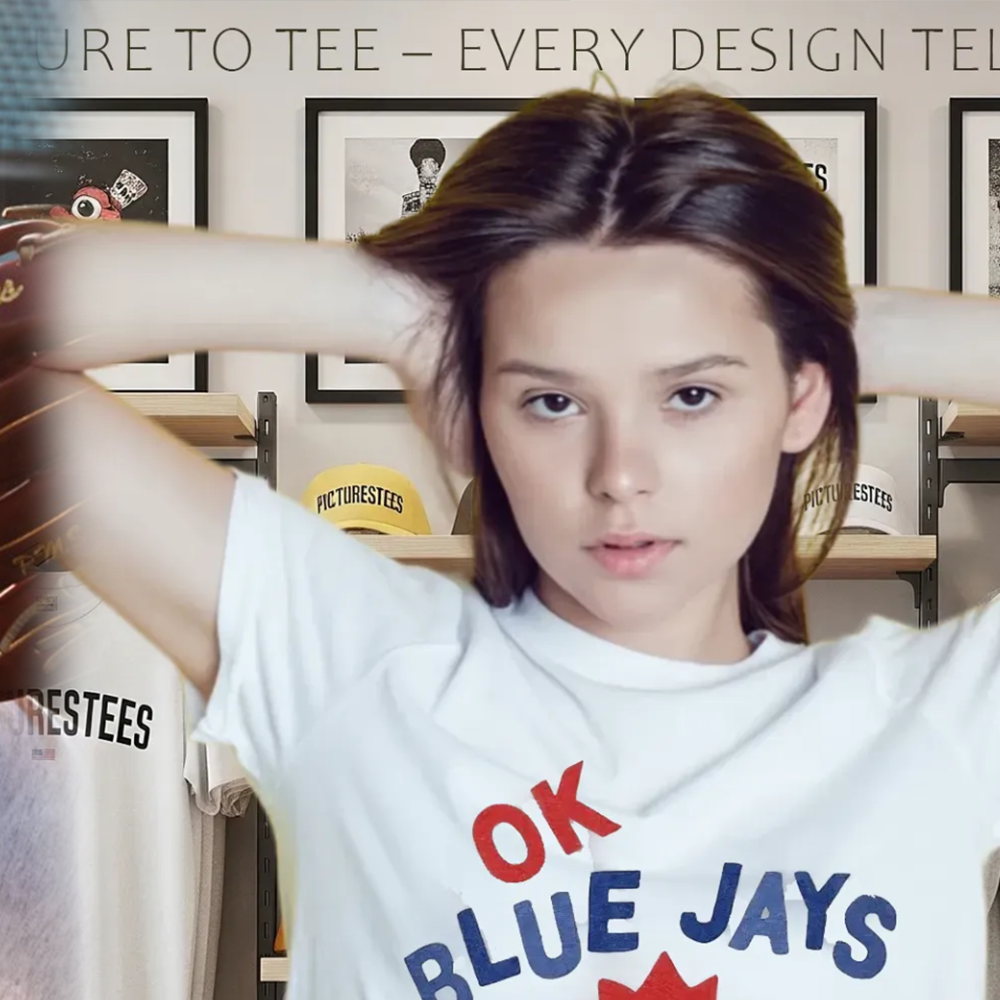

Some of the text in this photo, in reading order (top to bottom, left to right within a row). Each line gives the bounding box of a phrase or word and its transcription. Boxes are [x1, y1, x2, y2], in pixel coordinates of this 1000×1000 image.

[175, 28, 252, 72] TO
[275, 28, 380, 71] TEE
[460, 28, 645, 71] EVERY
[672, 28, 885, 72] DESIGN
[316, 485, 404, 514] PICTURESTEES
[472, 760, 622, 884] OK
[680, 863, 897, 980] JAYS
